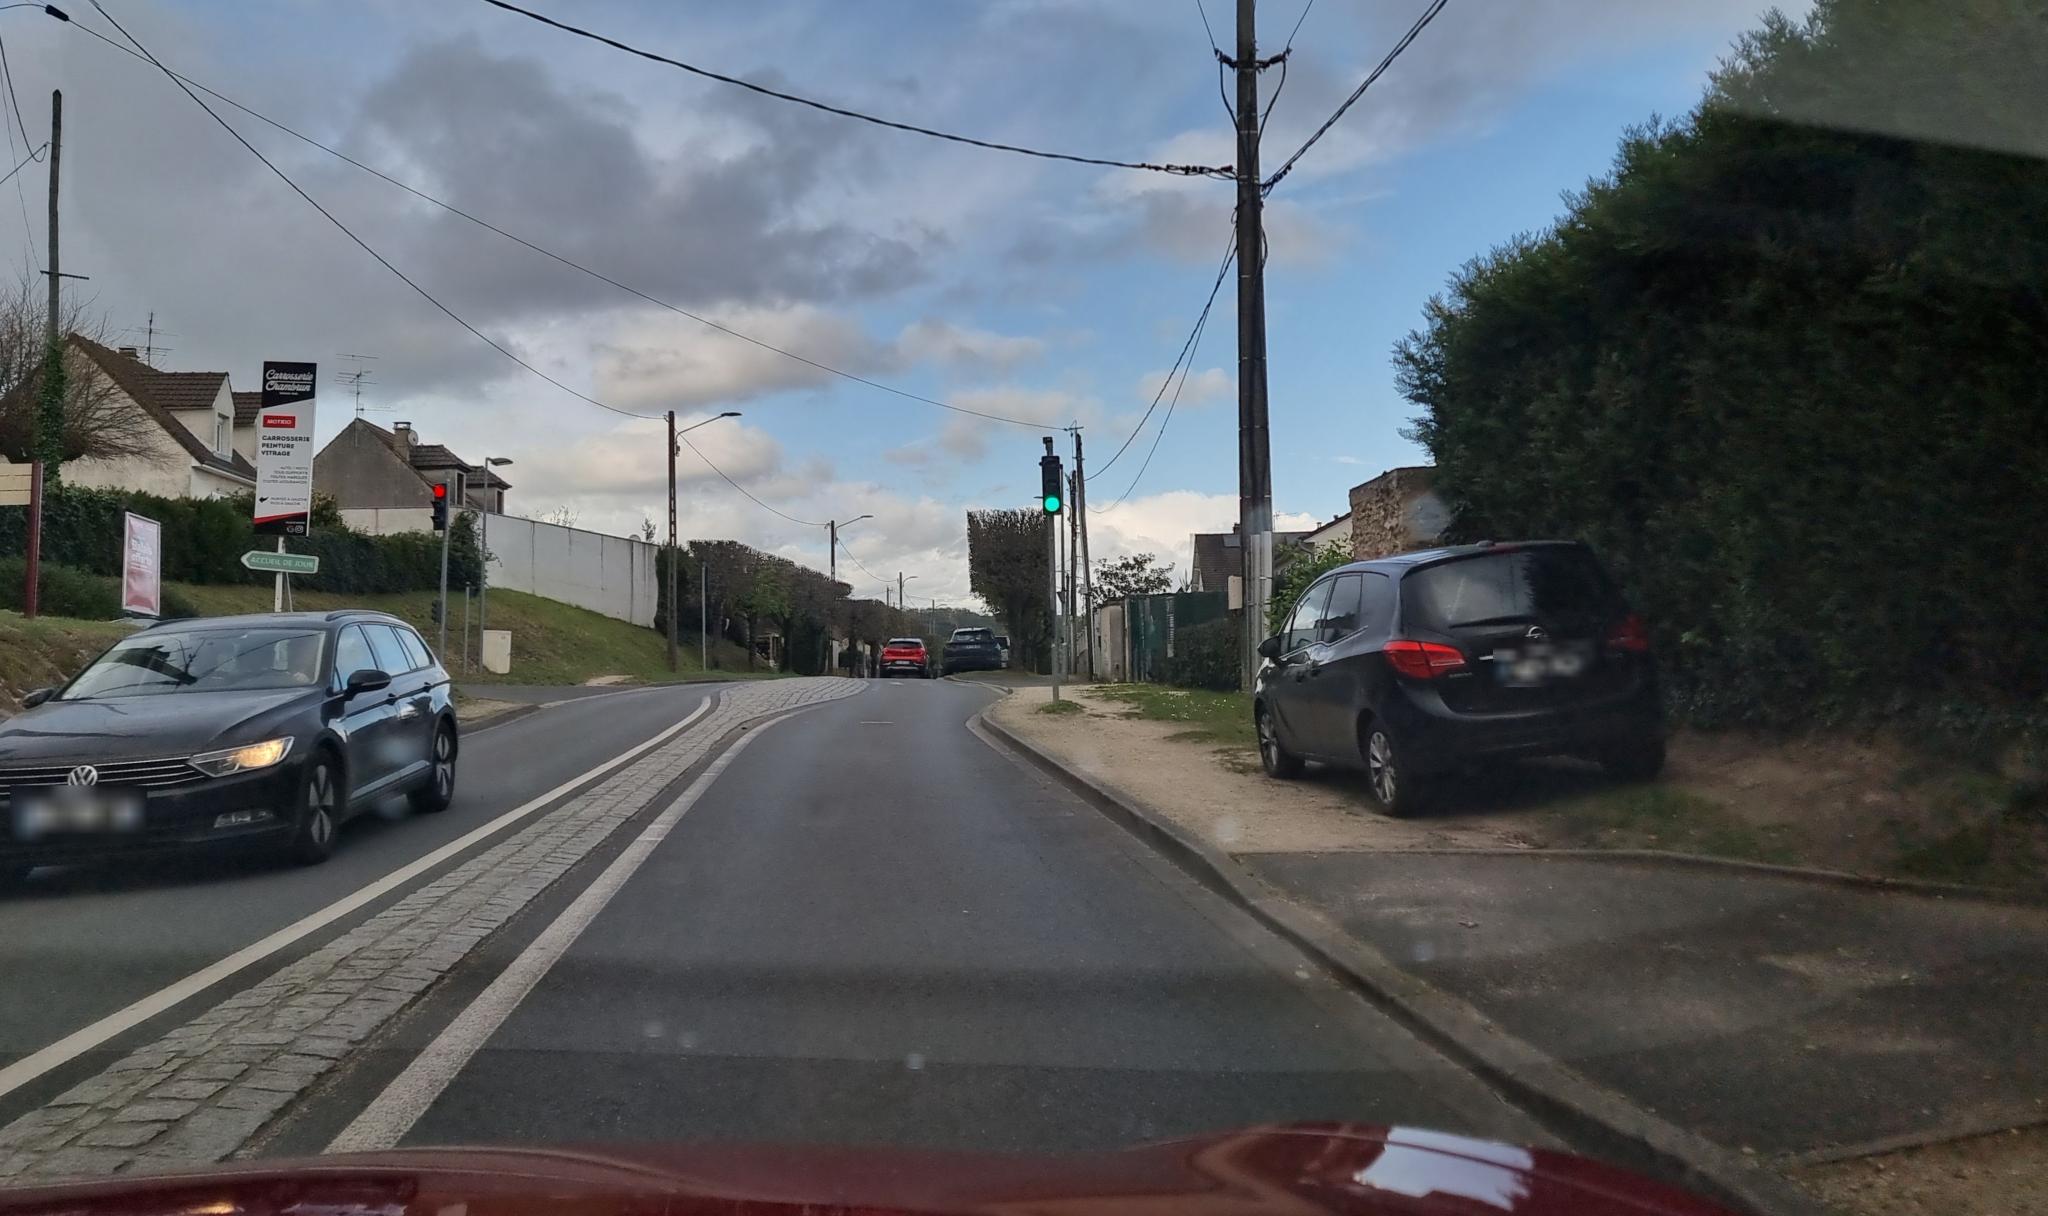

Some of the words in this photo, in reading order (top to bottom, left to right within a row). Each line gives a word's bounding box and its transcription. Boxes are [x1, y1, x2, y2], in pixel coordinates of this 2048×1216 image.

[265, 369, 314, 380] Carrosserie
[251, 556, 281, 566] ACCUEIL
[282, 559, 292, 567] DE
[294, 560, 314, 569] JOUR
